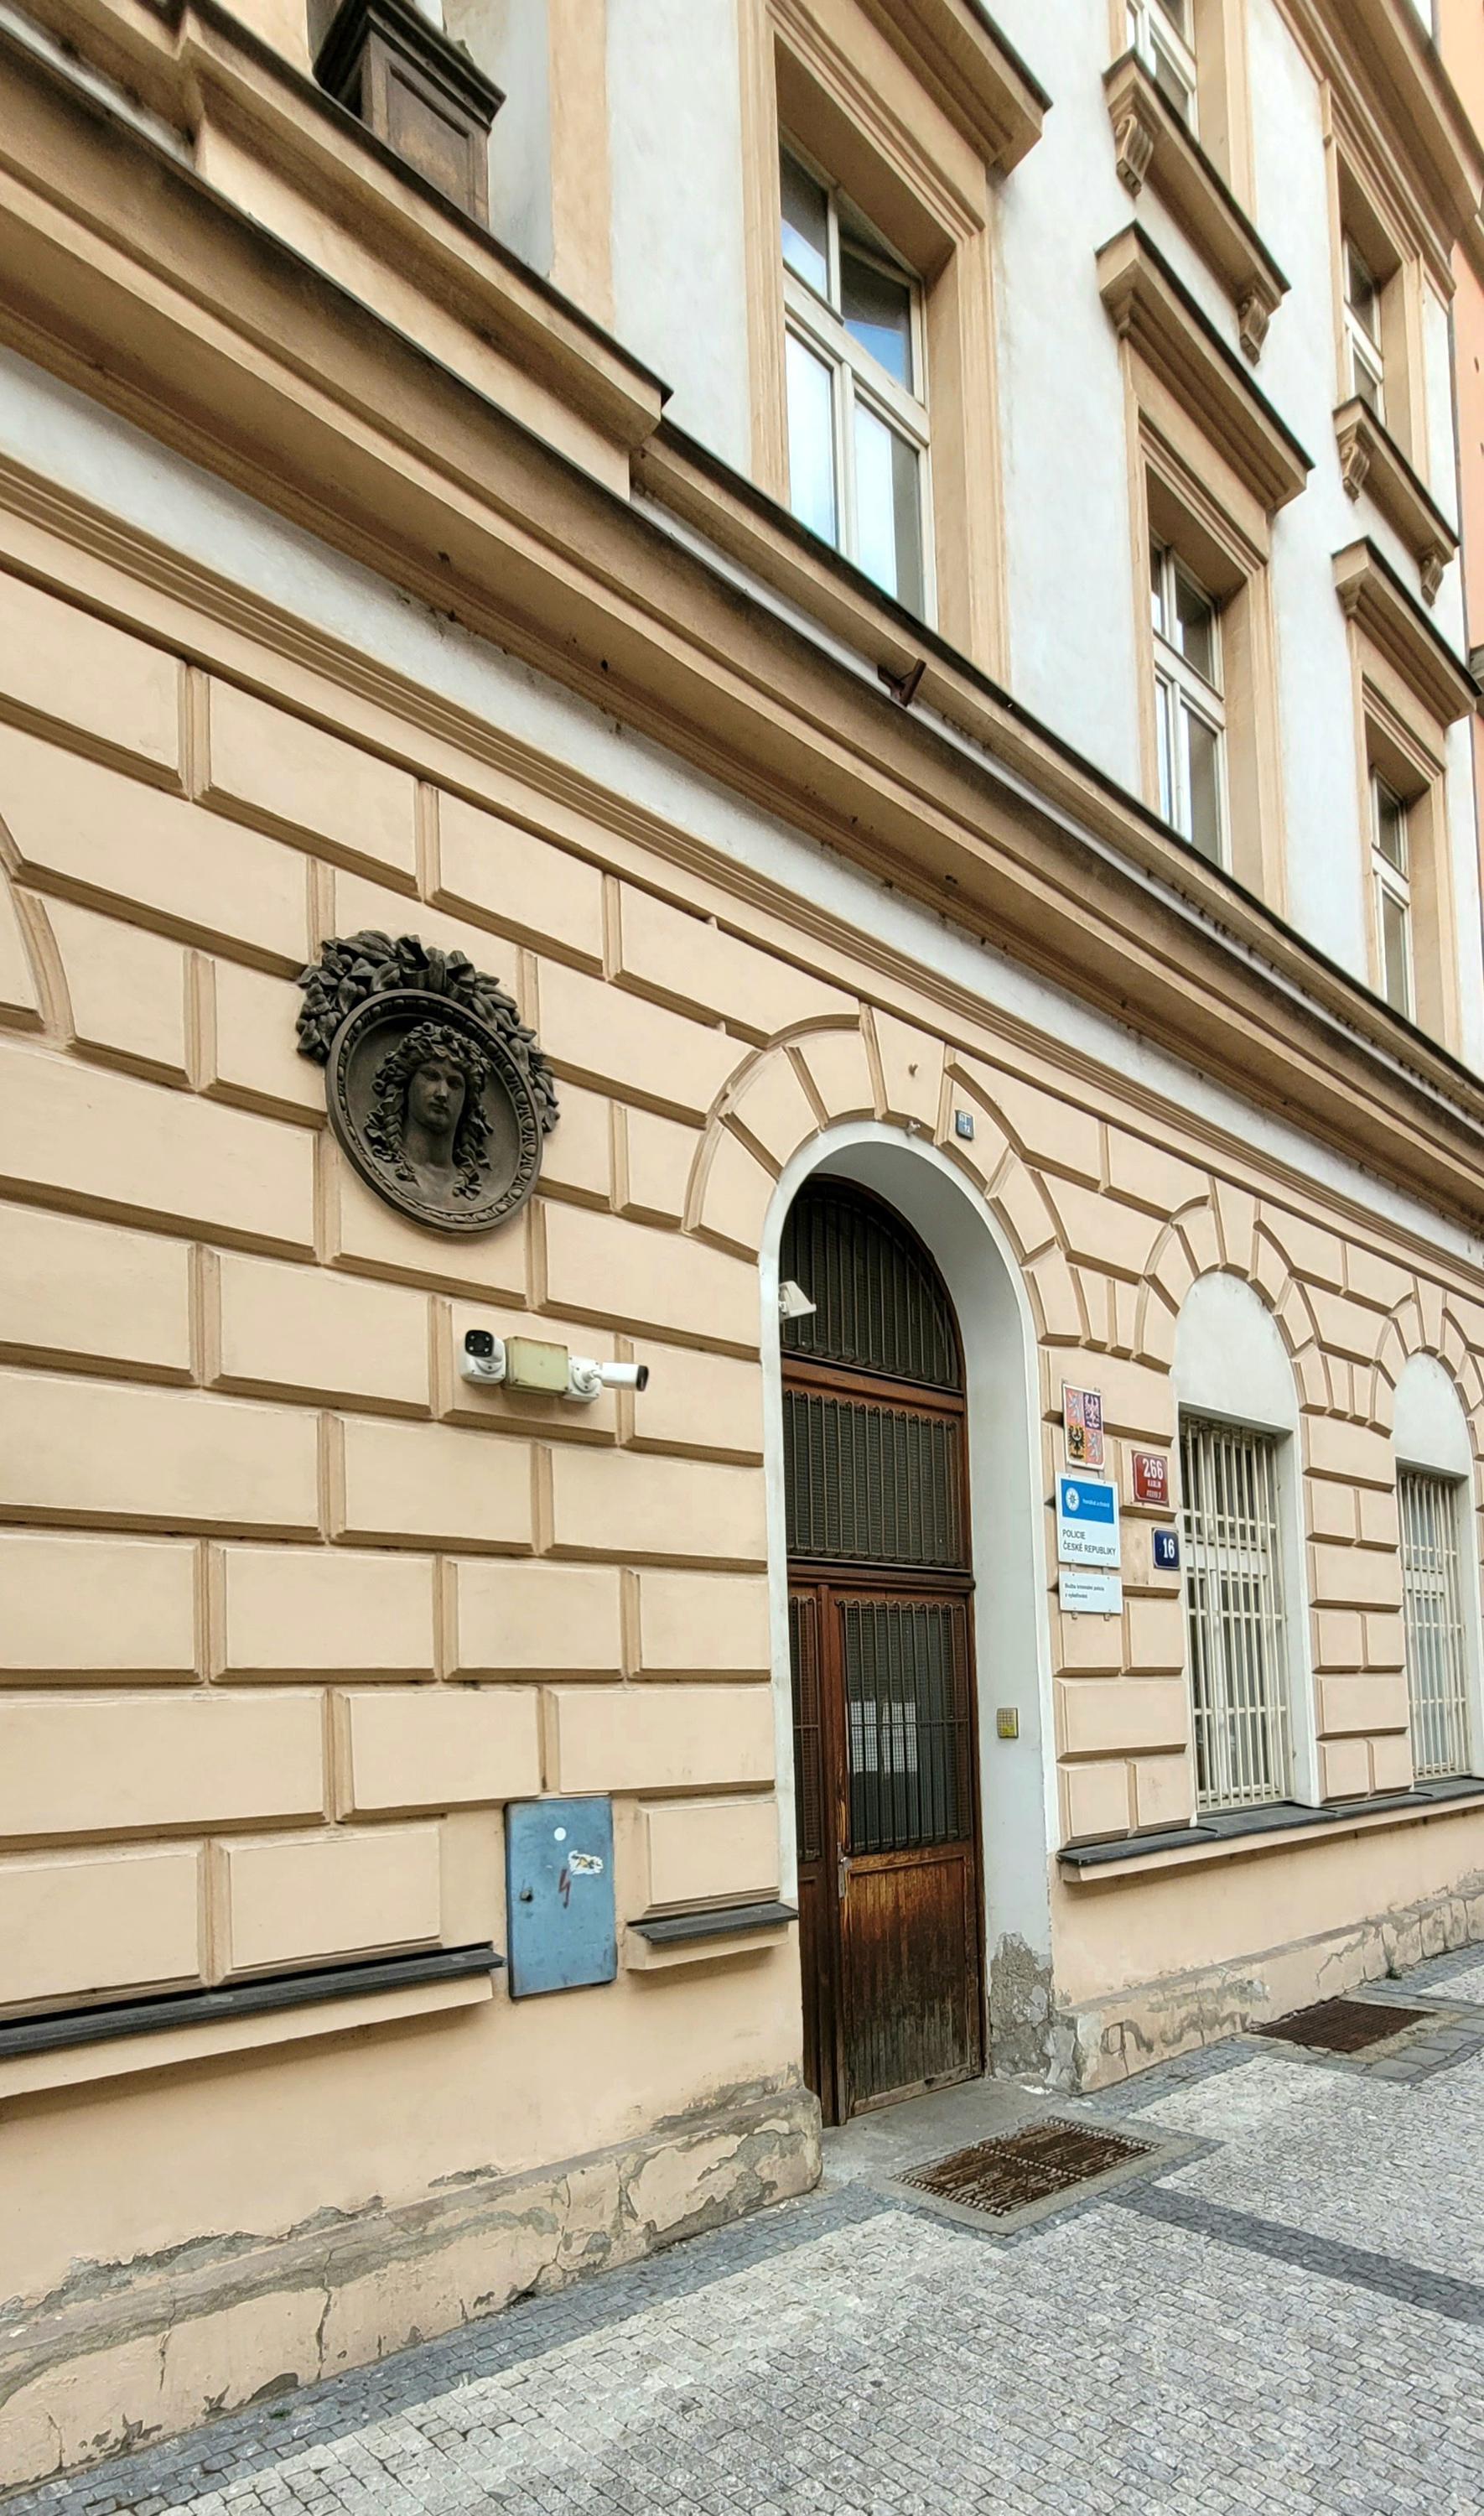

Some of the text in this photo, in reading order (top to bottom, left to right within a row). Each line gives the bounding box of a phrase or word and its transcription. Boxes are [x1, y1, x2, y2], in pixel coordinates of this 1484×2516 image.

[1142, 1458, 1164, 1480] 266
[1062, 1529, 1086, 1540] POLICIE
[1062, 1540, 1116, 1556] ČESKÉ REPUBLIKY
[1163, 1537, 1175, 1559] 16
